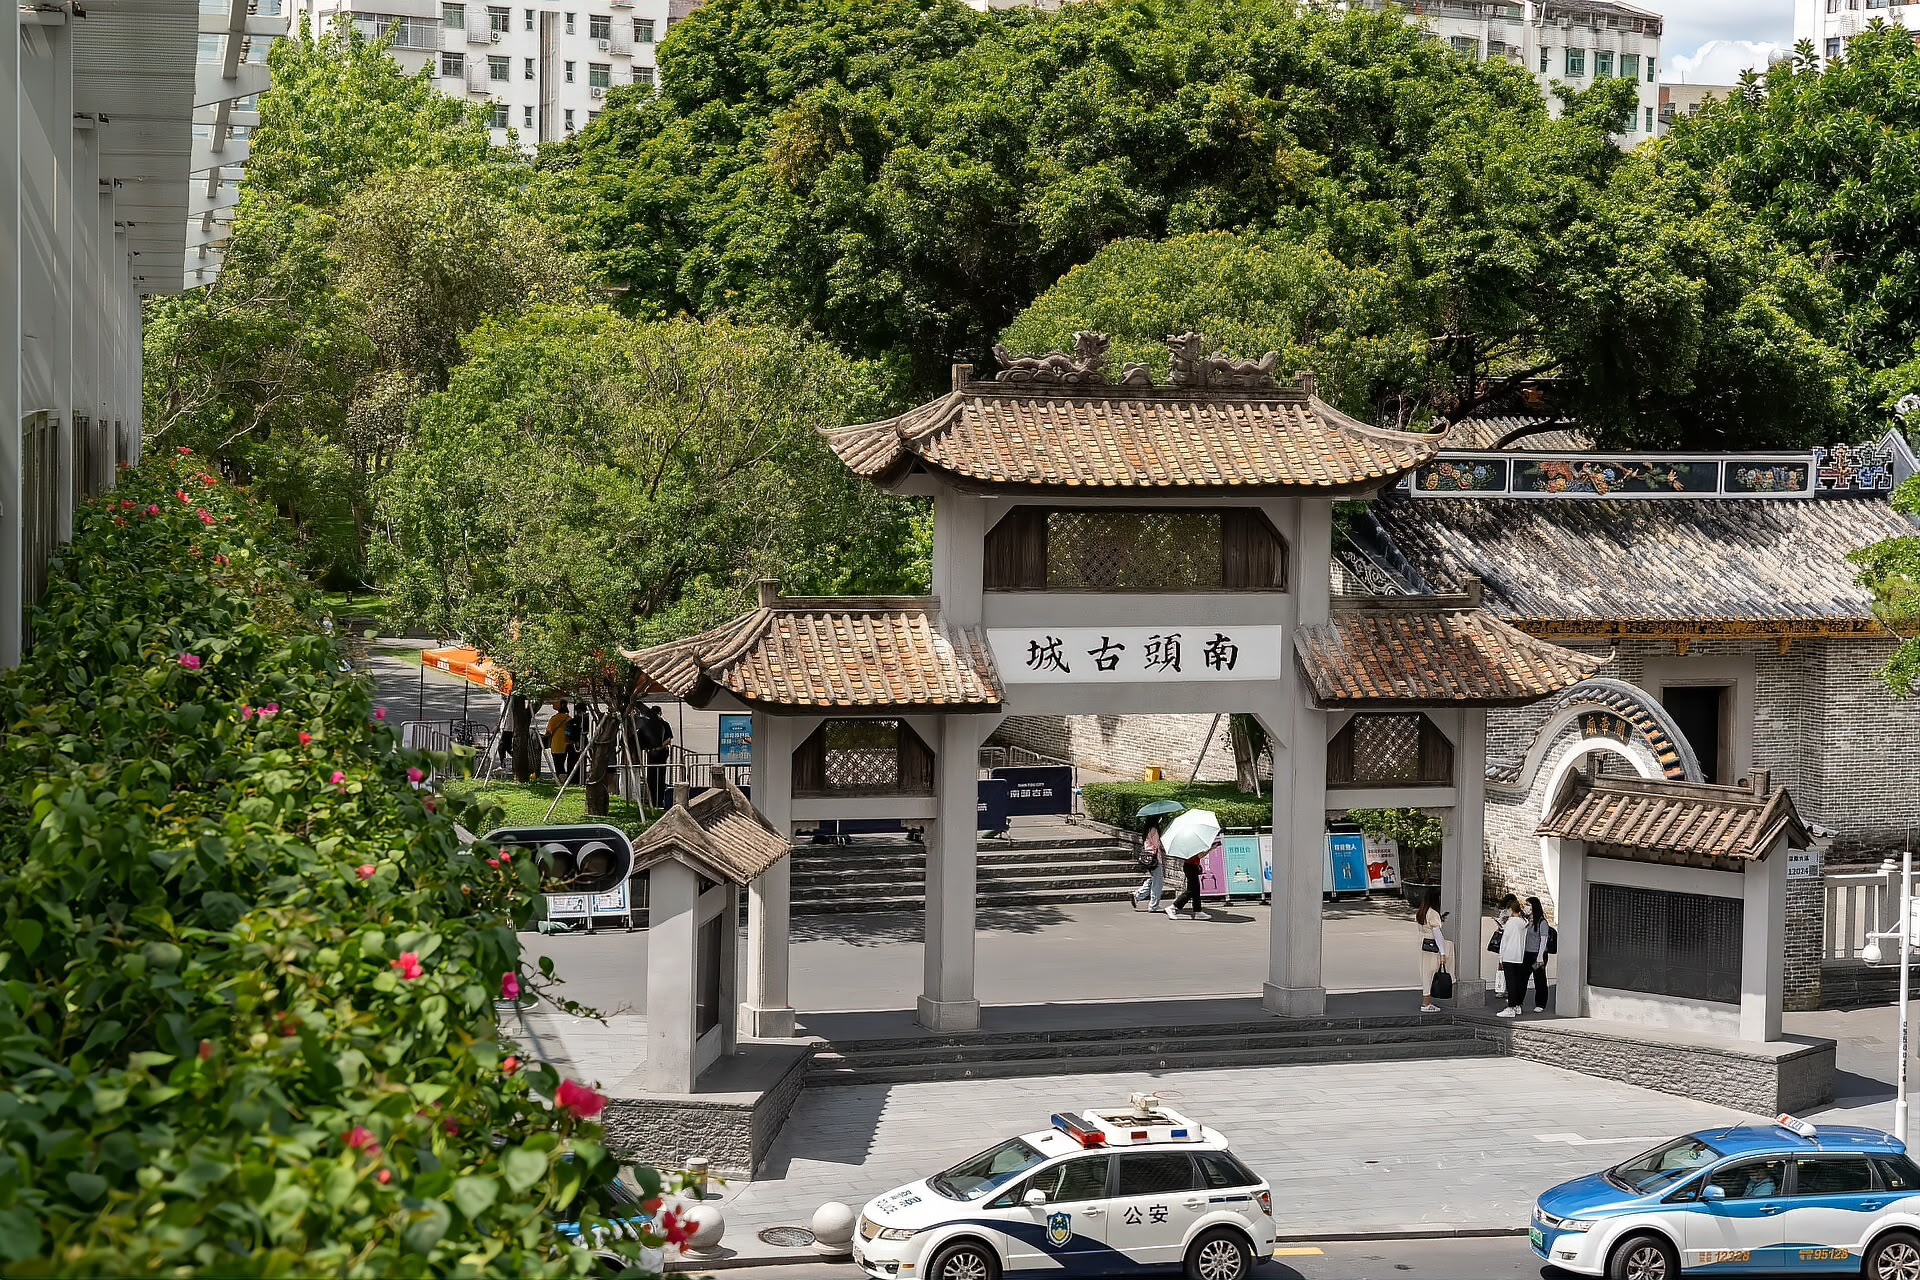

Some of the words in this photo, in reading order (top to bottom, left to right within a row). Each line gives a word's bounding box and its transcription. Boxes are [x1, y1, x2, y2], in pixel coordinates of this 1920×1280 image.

[1026, 632, 1240, 674] 南頭古城
[1123, 1203, 1169, 1225] 公安
